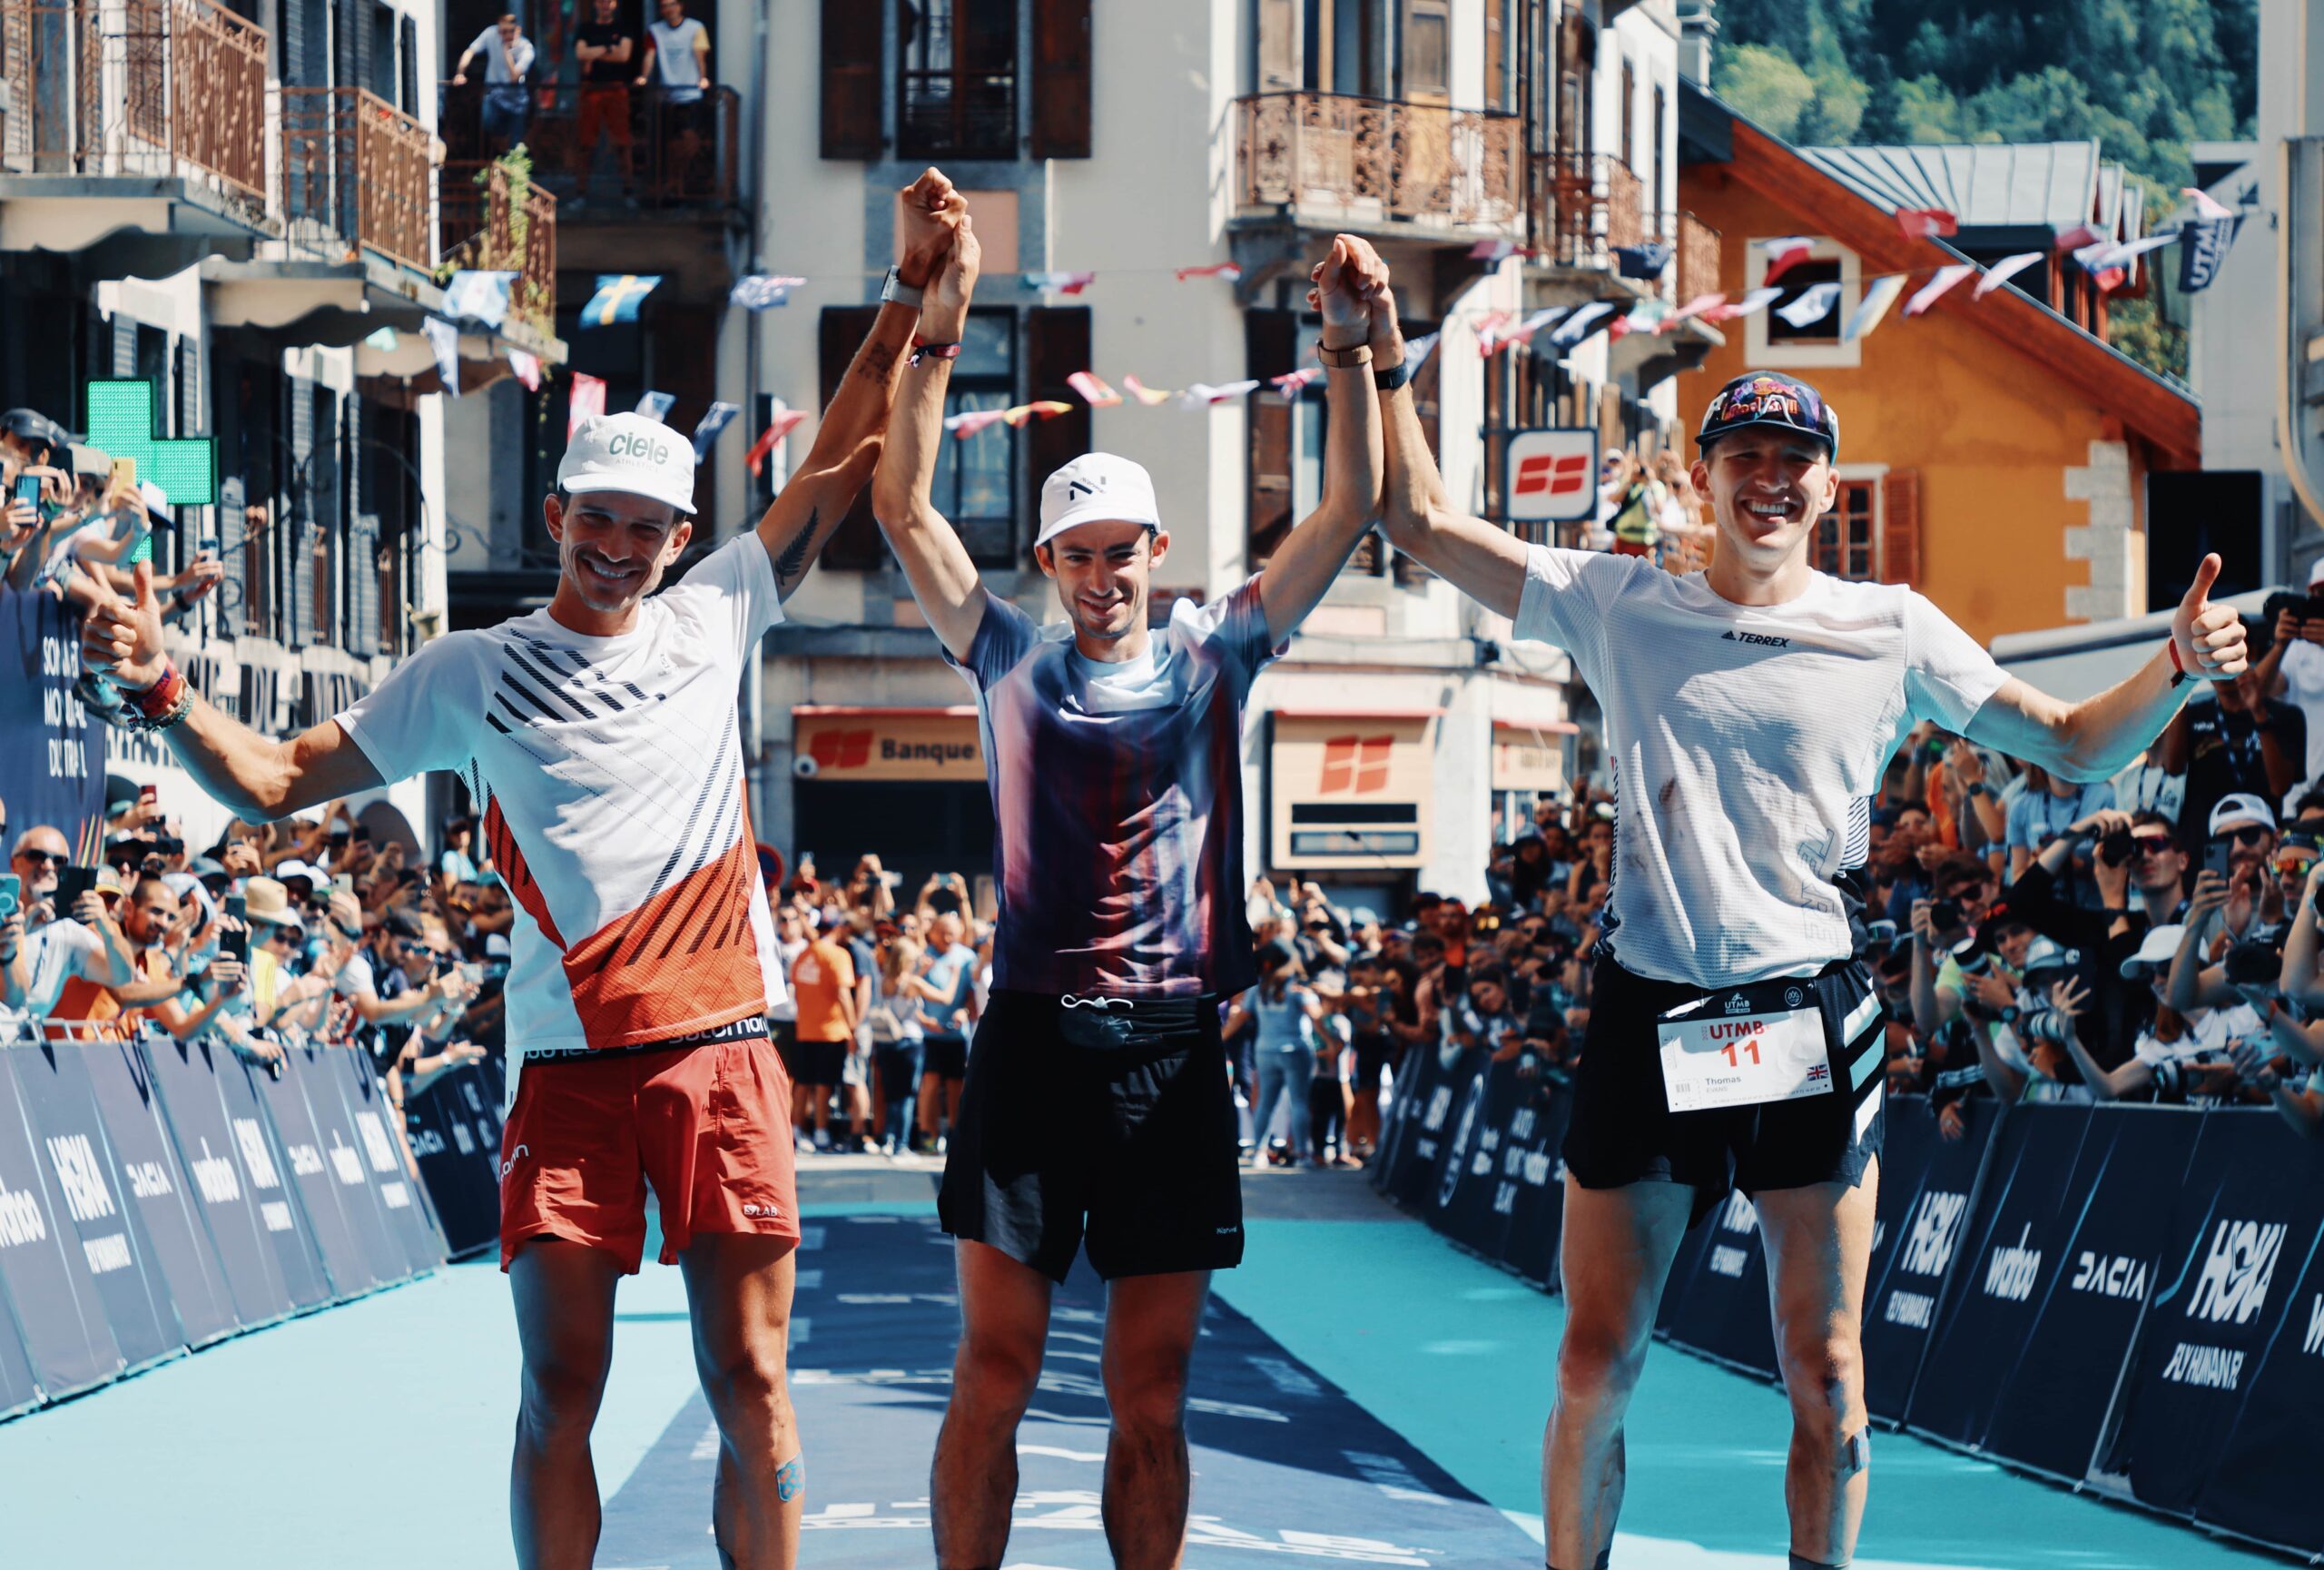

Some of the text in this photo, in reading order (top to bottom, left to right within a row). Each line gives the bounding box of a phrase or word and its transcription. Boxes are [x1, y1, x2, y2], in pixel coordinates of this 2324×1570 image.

[609, 432, 669, 465] ciele
[1738, 631, 1790, 647] TERREX
[881, 738, 975, 765] Banque
[1724, 1000, 1751, 1009] UTMB
[1709, 1020, 1766, 1041] UTMB
[1720, 1040, 1761, 1067] 11
[1705, 1075, 1742, 1086] Thomas
[1984, 1221, 2042, 1302] wahoo
[2186, 1219, 2288, 1325] HOKA
[2072, 1250, 2147, 1301] DACIA
